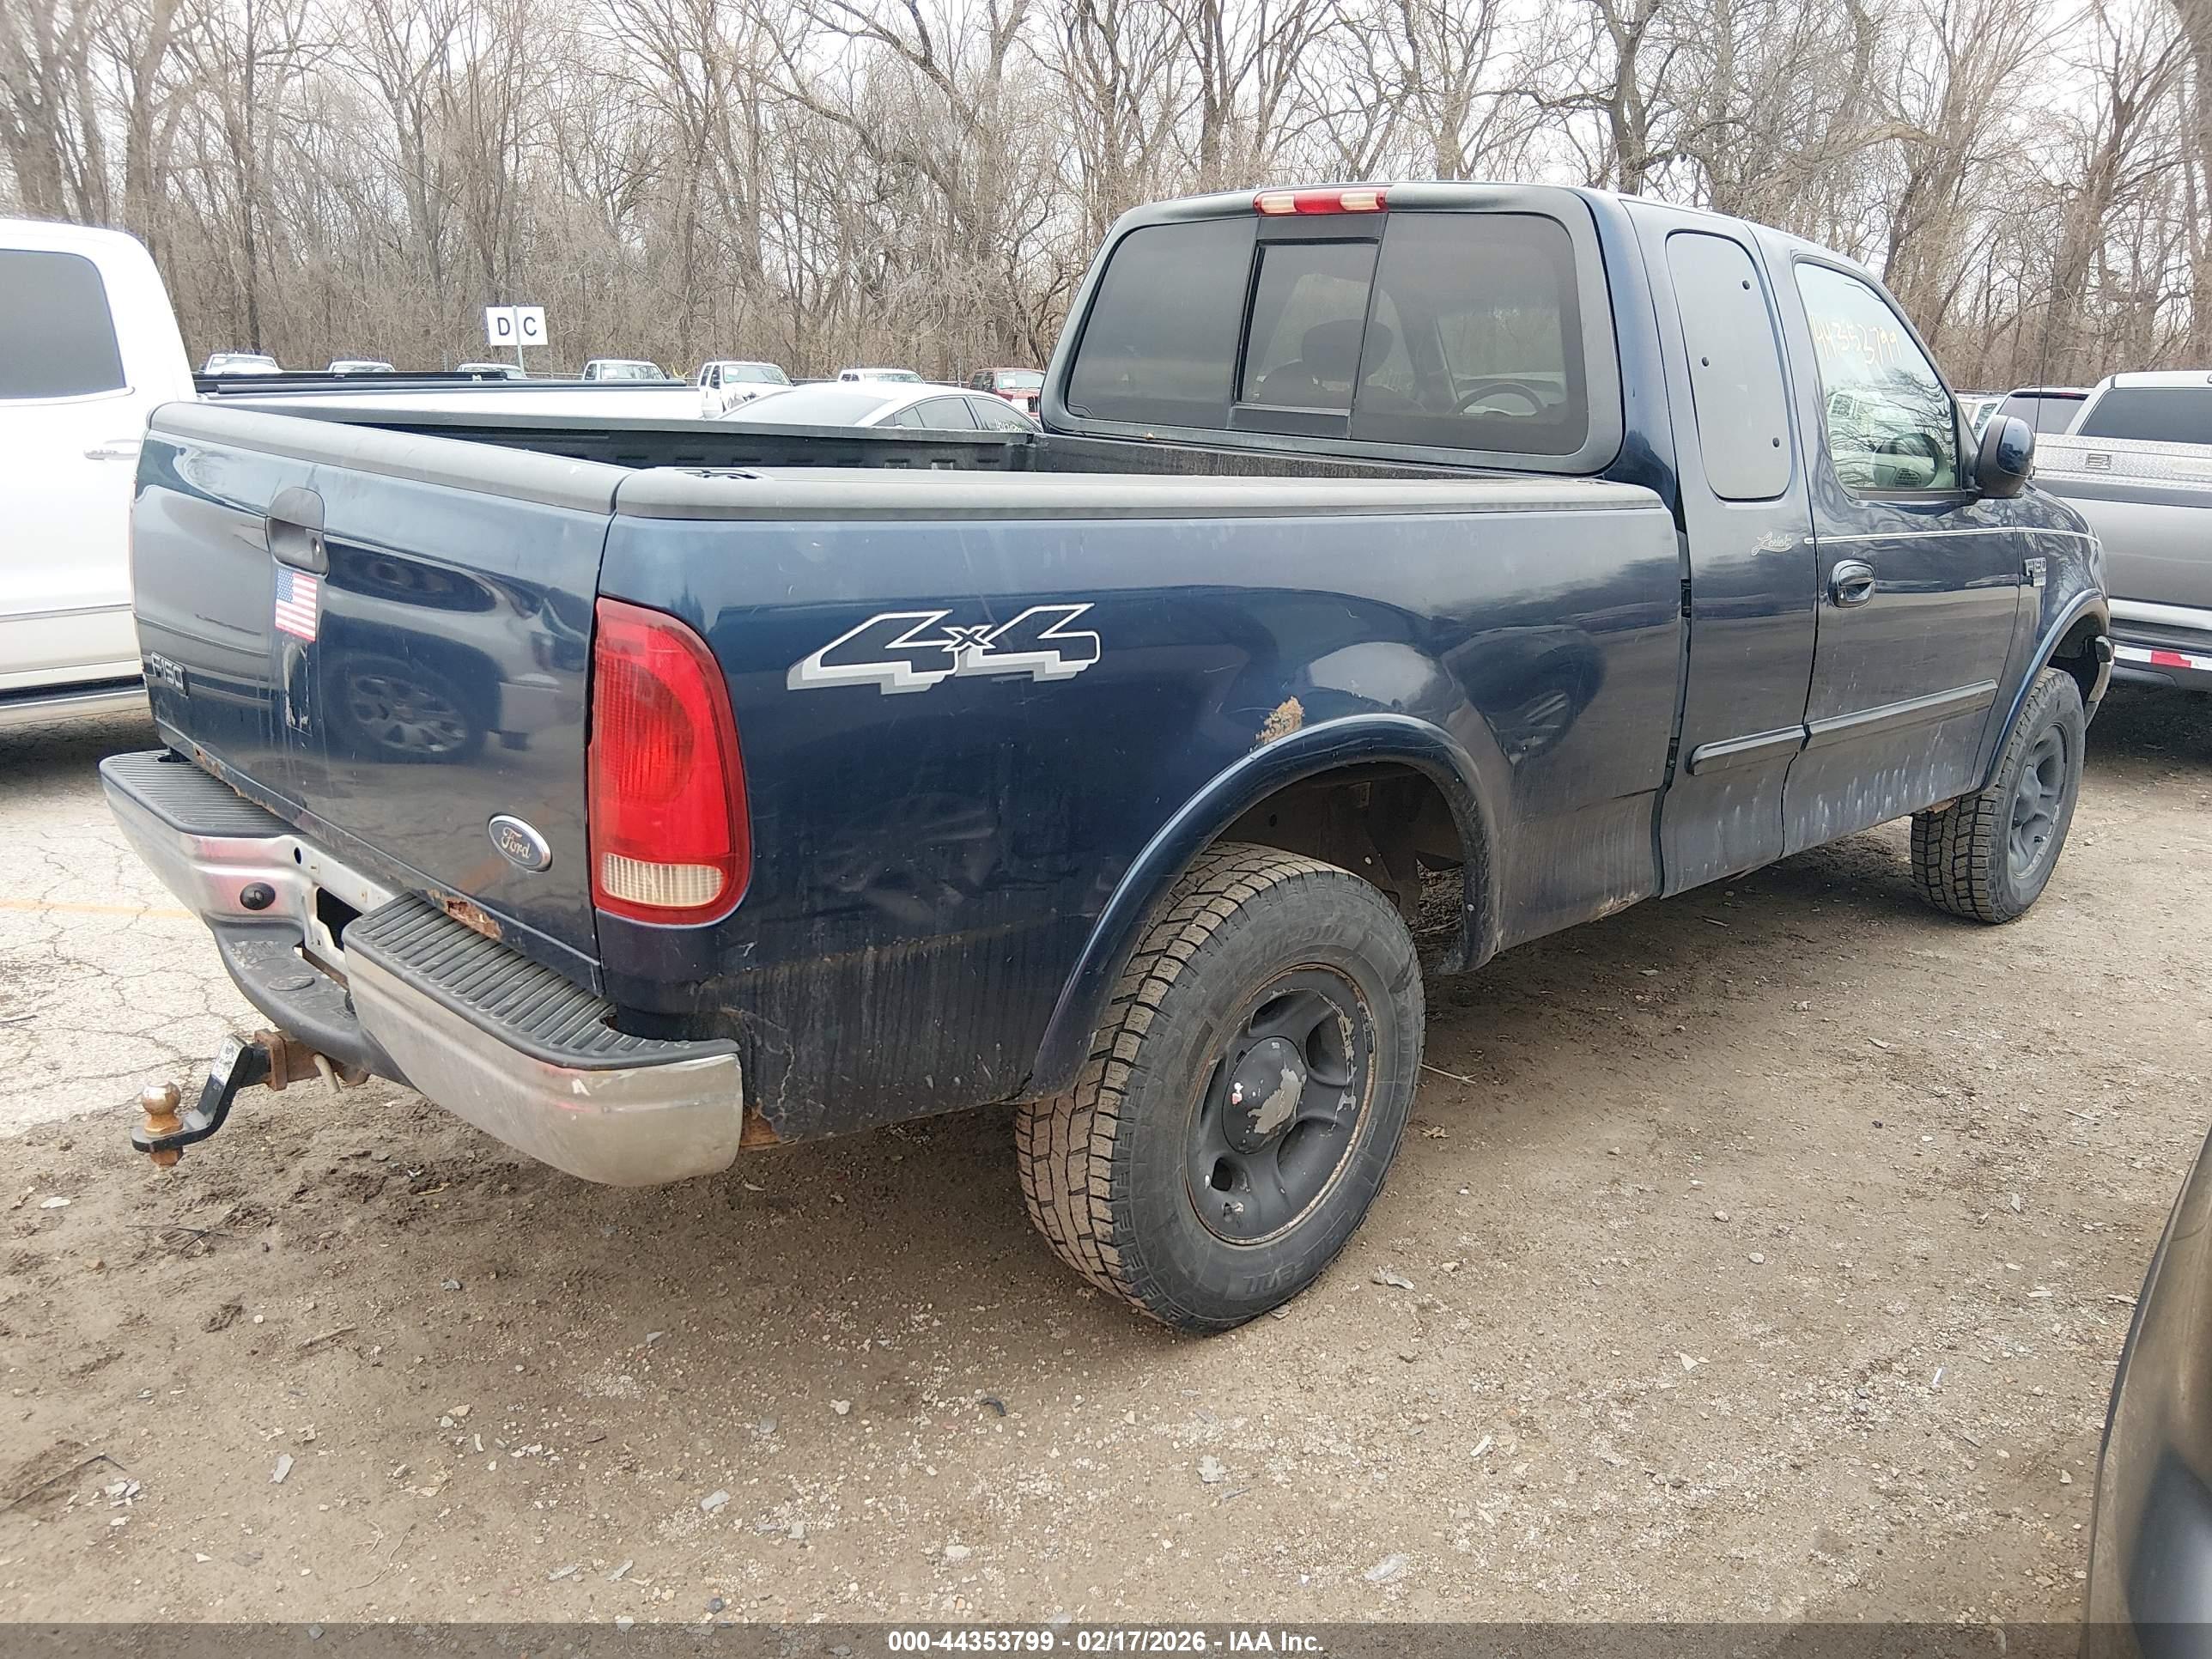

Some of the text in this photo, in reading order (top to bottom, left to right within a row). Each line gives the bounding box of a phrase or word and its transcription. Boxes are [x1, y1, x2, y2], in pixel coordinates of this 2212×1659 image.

[497, 317, 511, 337] D
[523, 316, 537, 337] C
[501, 826, 532, 859] Ford
